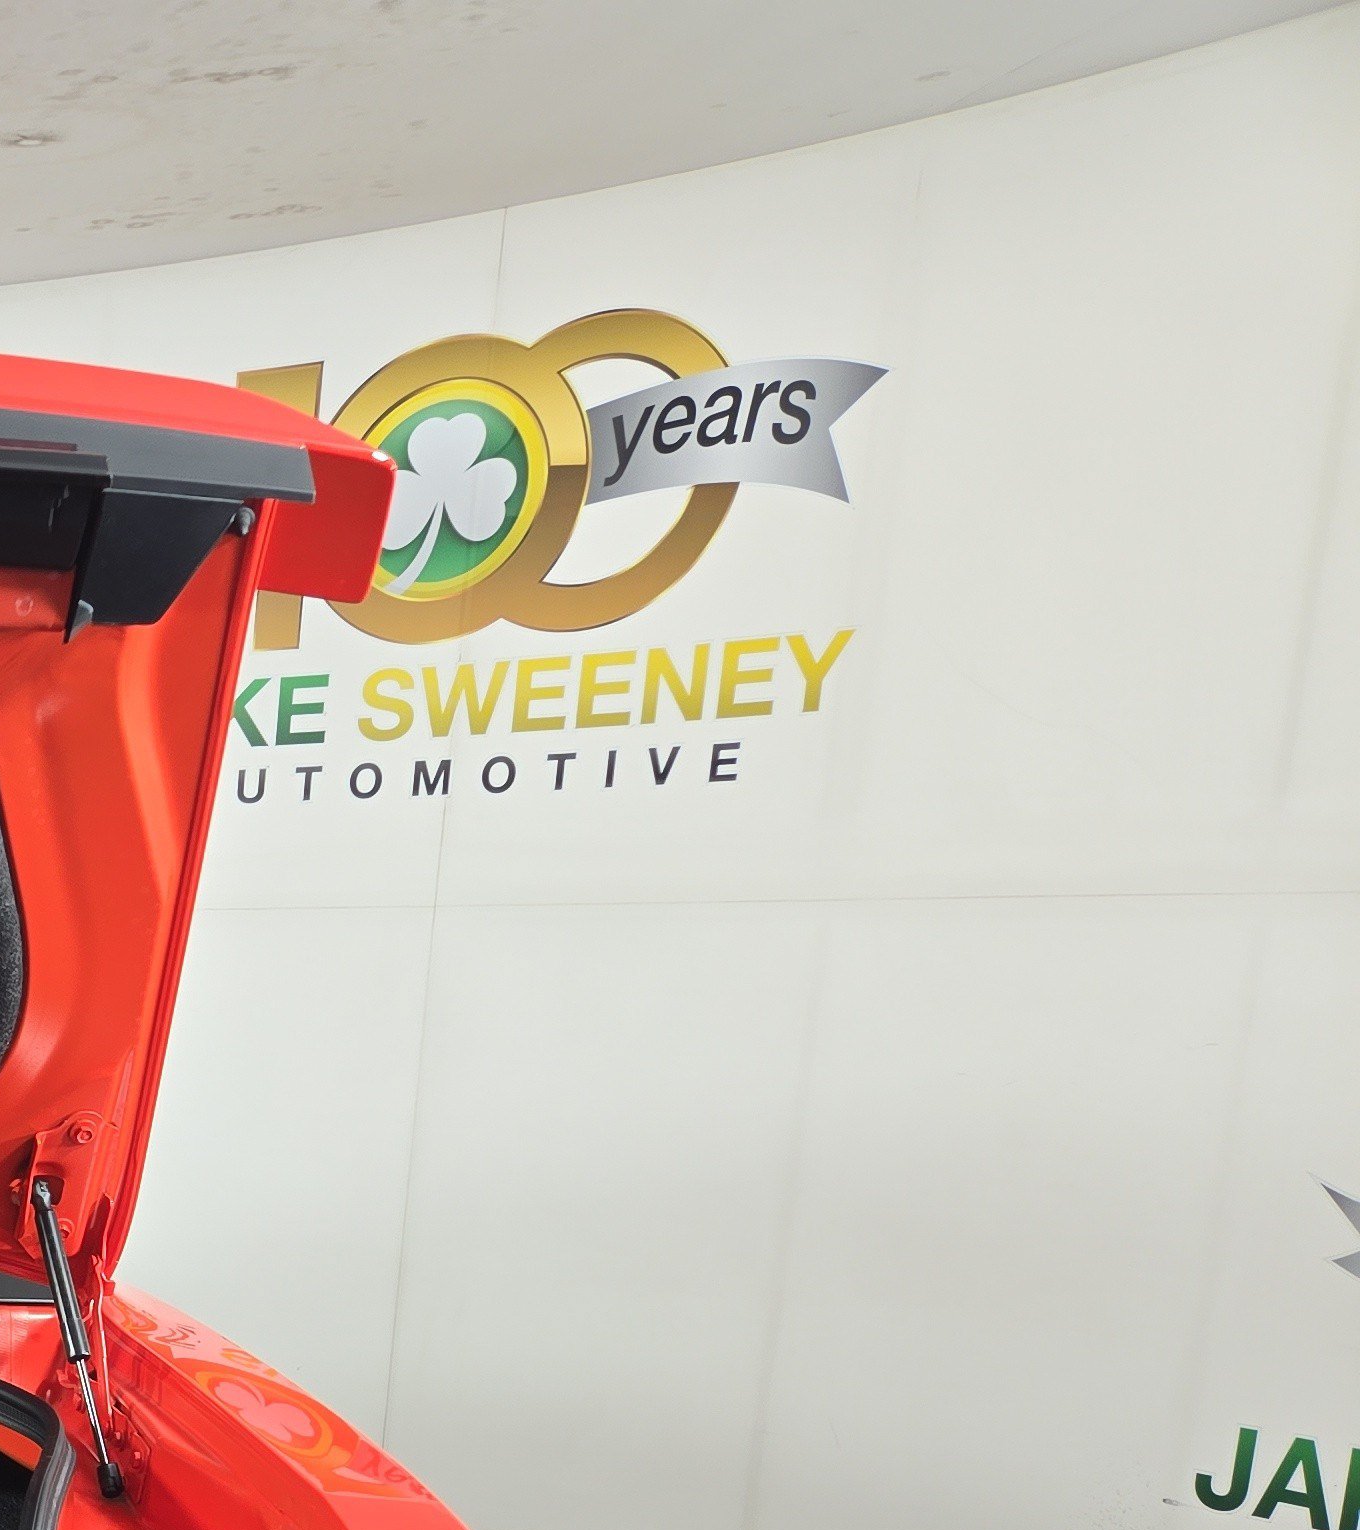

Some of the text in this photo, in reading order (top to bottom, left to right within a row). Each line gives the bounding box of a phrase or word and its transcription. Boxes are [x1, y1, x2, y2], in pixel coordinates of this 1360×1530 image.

[603, 378, 817, 487] years
[358, 628, 856, 742] SWEENEY
[237, 742, 742, 804] UTOMOTIVE
